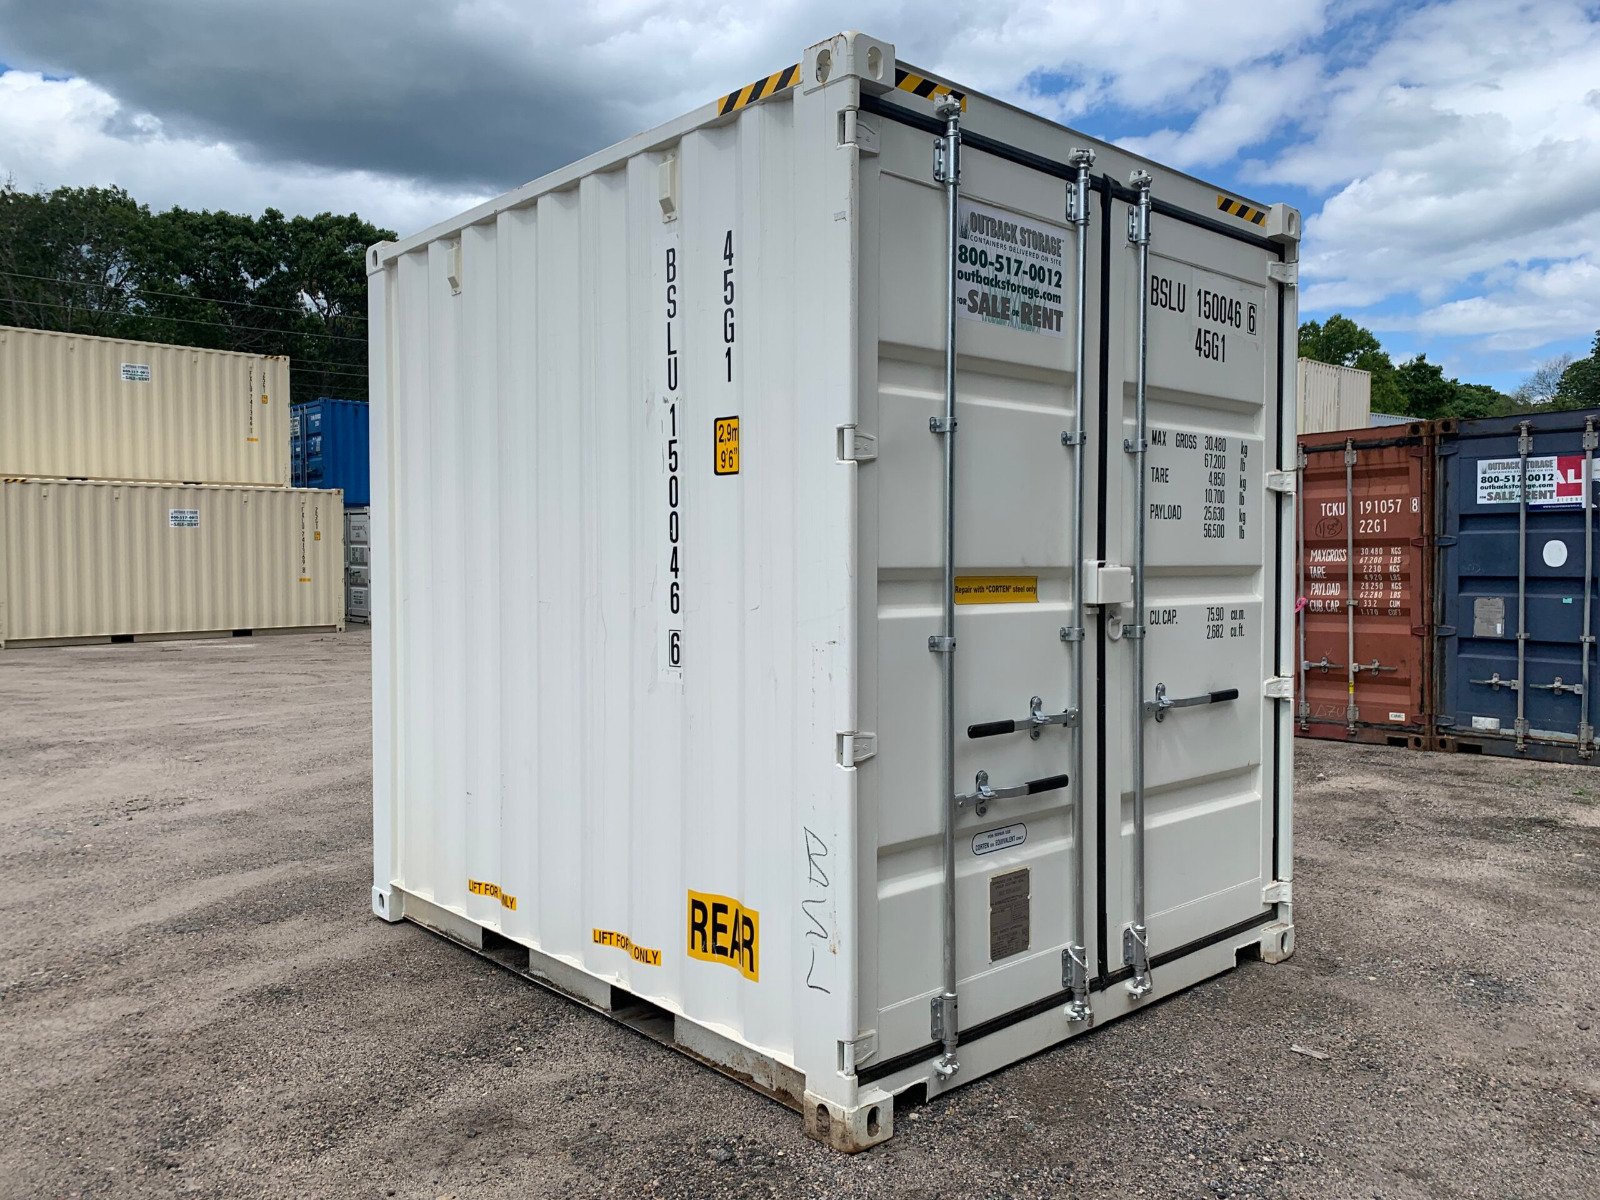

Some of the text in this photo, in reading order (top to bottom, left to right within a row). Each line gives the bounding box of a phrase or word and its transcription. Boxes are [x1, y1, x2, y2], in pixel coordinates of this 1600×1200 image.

[970, 212, 1062, 258] OUTBACK STORAGE
[969, 234, 1062, 267] CONTAINERS DELIVERED ON SITE
[958, 244, 1063, 288] 800-517-0012
[957, 269, 1062, 304] outbackstorage.com
[723, 230, 735, 382] 45G1
[967, 289, 1010, 321] SALE
[1011, 309, 1019, 317] OR
[1021, 302, 1064, 332] RENT
[1151, 275, 1256, 332] BSLU 150046 6
[666, 248, 678, 390] BSLU
[1195, 328, 1225, 362] 45G1
[1152, 430, 1167, 446] MAX
[1175, 433, 1197, 449] GROSS
[1240, 441, 1248, 458] kg
[1240, 458, 1245, 471] lb
[1487, 460, 1553, 471] OUTBACK TORAGE
[1151, 467, 1169, 483] TARE
[1239, 475, 1246, 491] kg
[1239, 491, 1244, 505] lb
[1487, 491, 1515, 501] SALE
[668, 403, 680, 614] 150046
[1150, 504, 1182, 520] PAYLOAD
[1239, 508, 1246, 525] kg
[1321, 498, 1418, 517] TCKU 191057 8
[1239, 525, 1245, 539] lb
[1359, 519, 1387, 533] 22G1
[1390, 556, 1401, 564] LBS
[1391, 547, 1402, 555] KGS
[1309, 566, 1327, 579] TARE
[1389, 565, 1400, 573] KGS
[955, 586, 972, 595] Repair
[973, 586, 985, 594] with
[1013, 585, 1025, 593] steel
[1026, 585, 1036, 594] only
[1310, 583, 1341, 596] PAYLOAD
[1391, 582, 1402, 590] KGS
[1390, 591, 1401, 599] LBS
[485, 883, 501, 899] FOR
[691, 898, 755, 973] REAR
[593, 929, 659, 965] LIFT FOR ONLY
